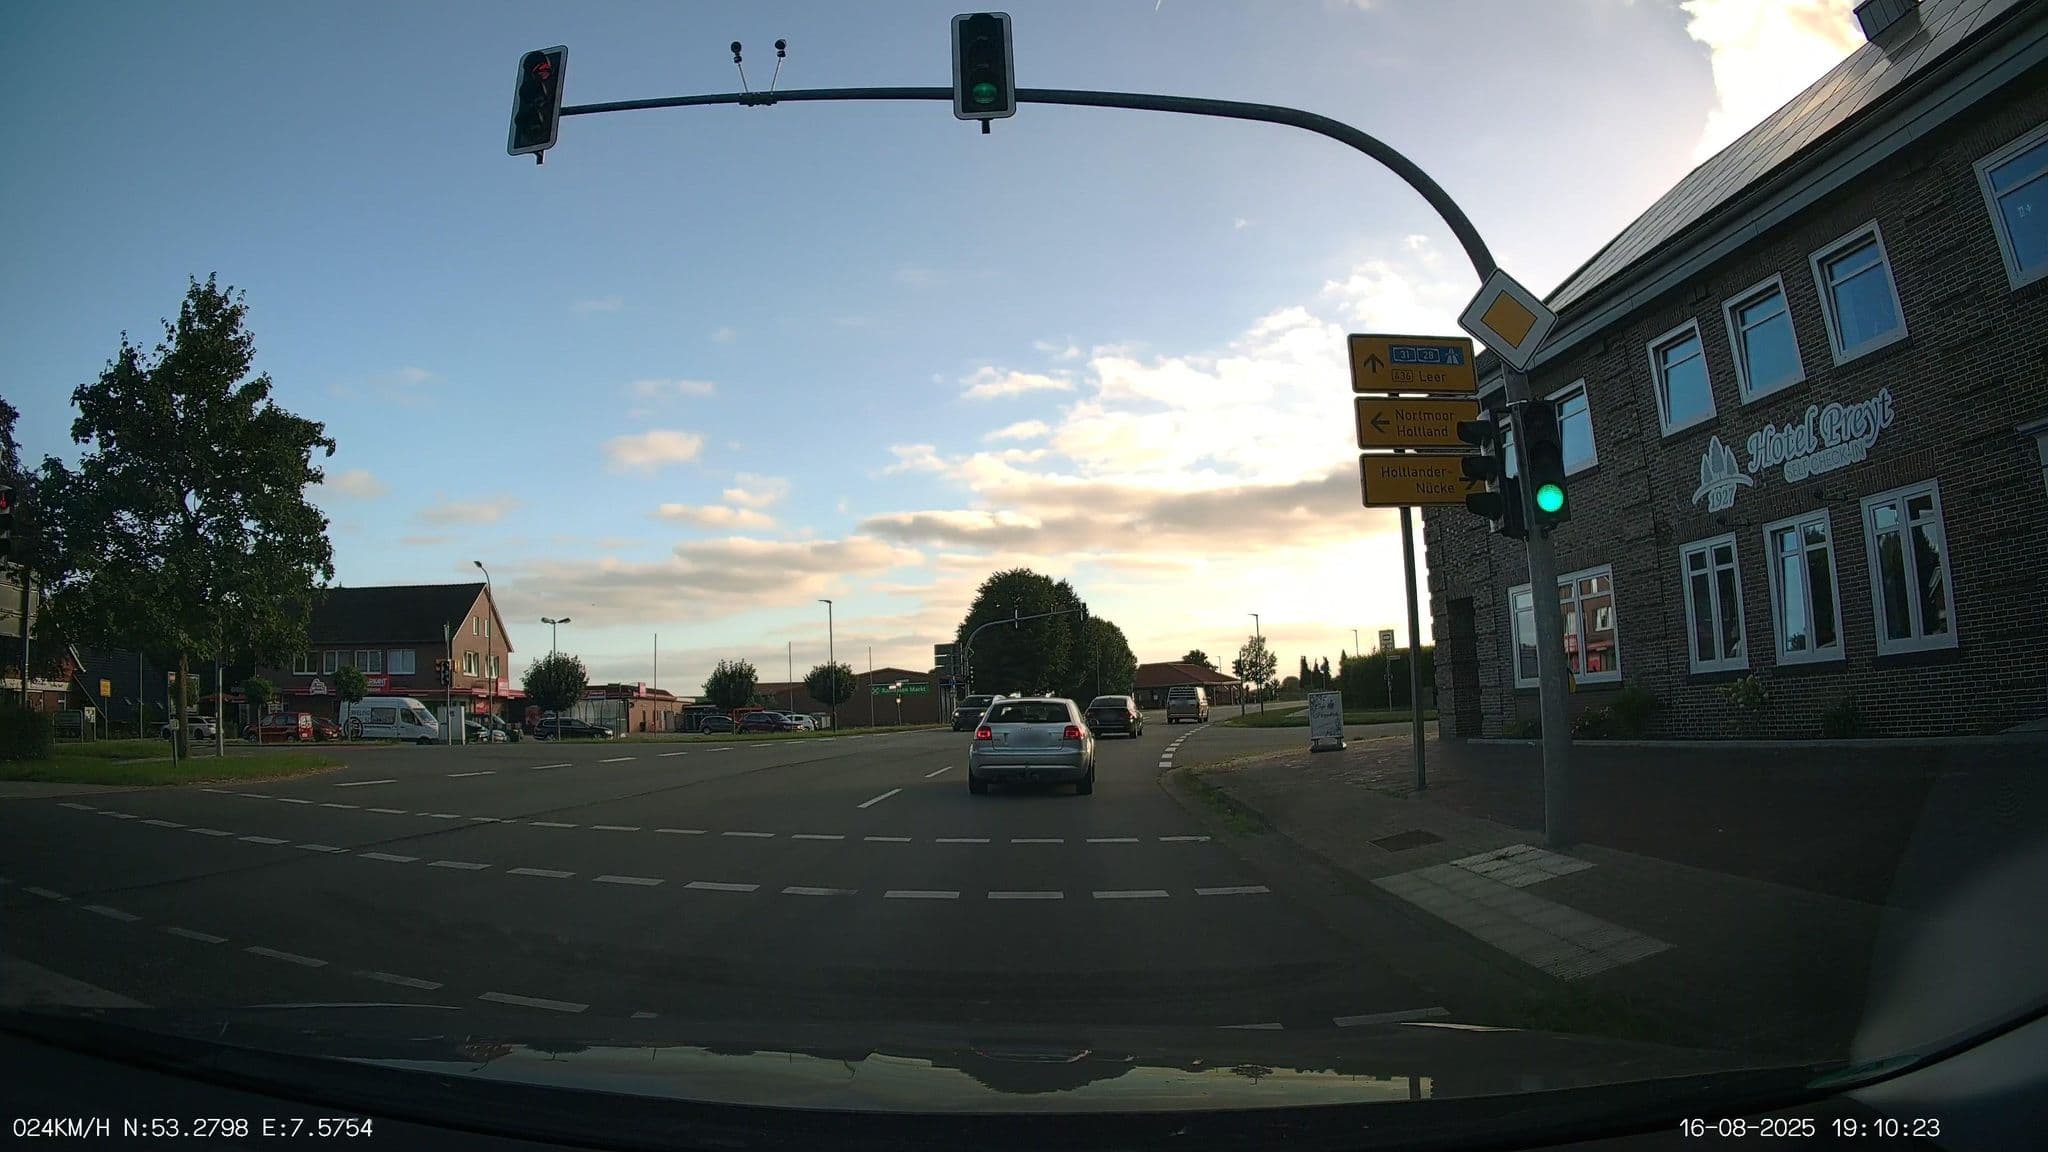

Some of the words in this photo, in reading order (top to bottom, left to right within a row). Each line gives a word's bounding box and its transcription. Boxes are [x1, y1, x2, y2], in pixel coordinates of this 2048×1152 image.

[1400, 350, 1410, 360] 31
[1423, 349, 1434, 360] 28
[1394, 371, 1412, 382] 436
[1419, 371, 1446, 382] Leer
[1395, 409, 1455, 422] Nortmoor
[1397, 424, 1449, 437] Holtland
[1748, 405, 1818, 472] Hotel
[1821, 388, 1894, 449] Preyt
[1785, 460, 1809, 480] SELF
[1811, 441, 1865, 474] CHECK-IN
[1381, 465, 1453, 478] Holtlander-
[1416, 481, 1456, 495] Nücke
[1710, 486, 1735, 509] 1927
